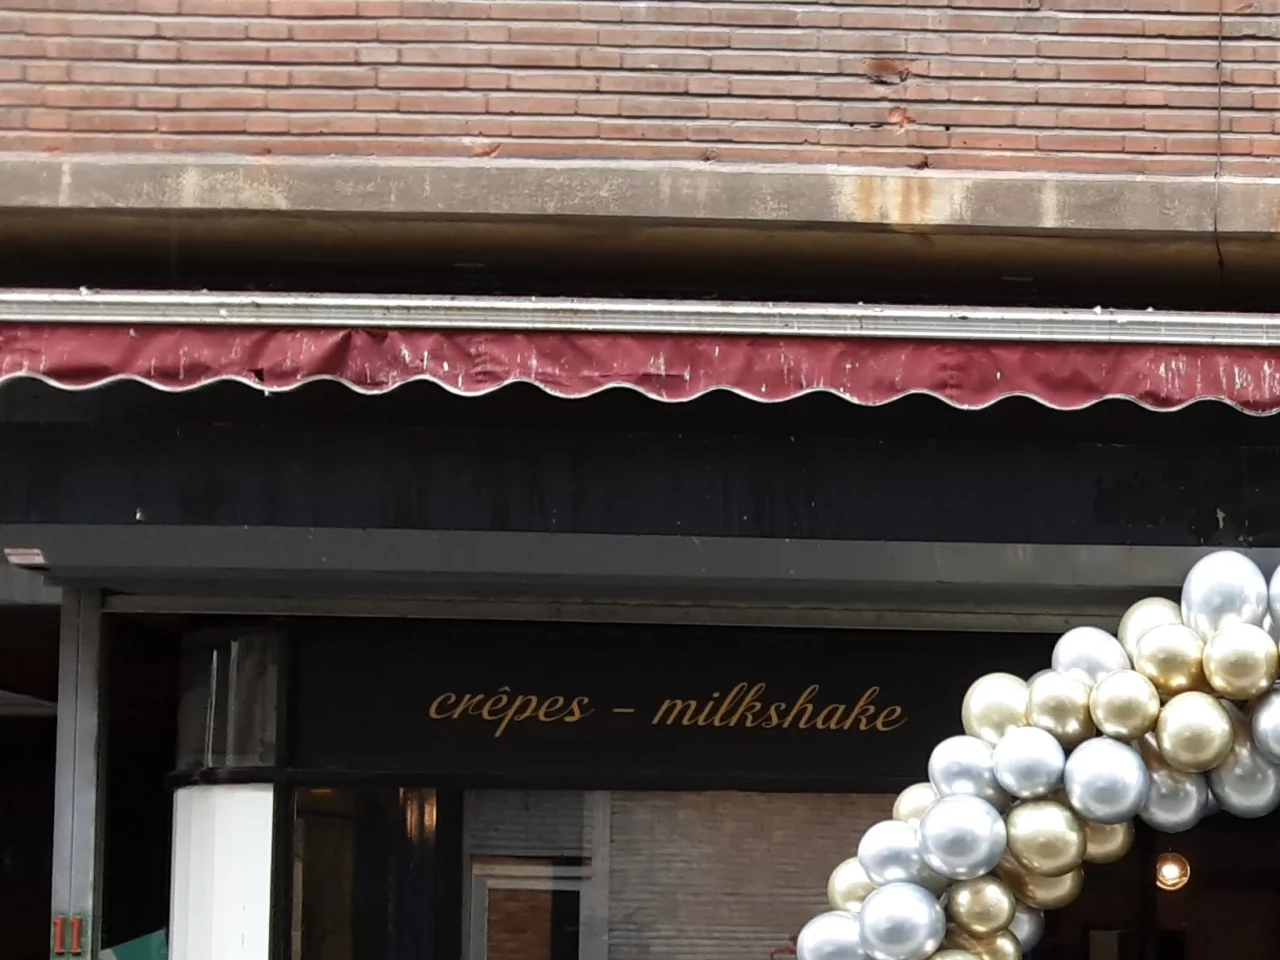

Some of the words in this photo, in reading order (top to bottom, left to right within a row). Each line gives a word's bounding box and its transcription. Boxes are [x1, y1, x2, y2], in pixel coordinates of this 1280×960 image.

[428, 685, 595, 738] crêpes
[651, 682, 908, 732] milkshake
[53, 915, 82, 955] 11
